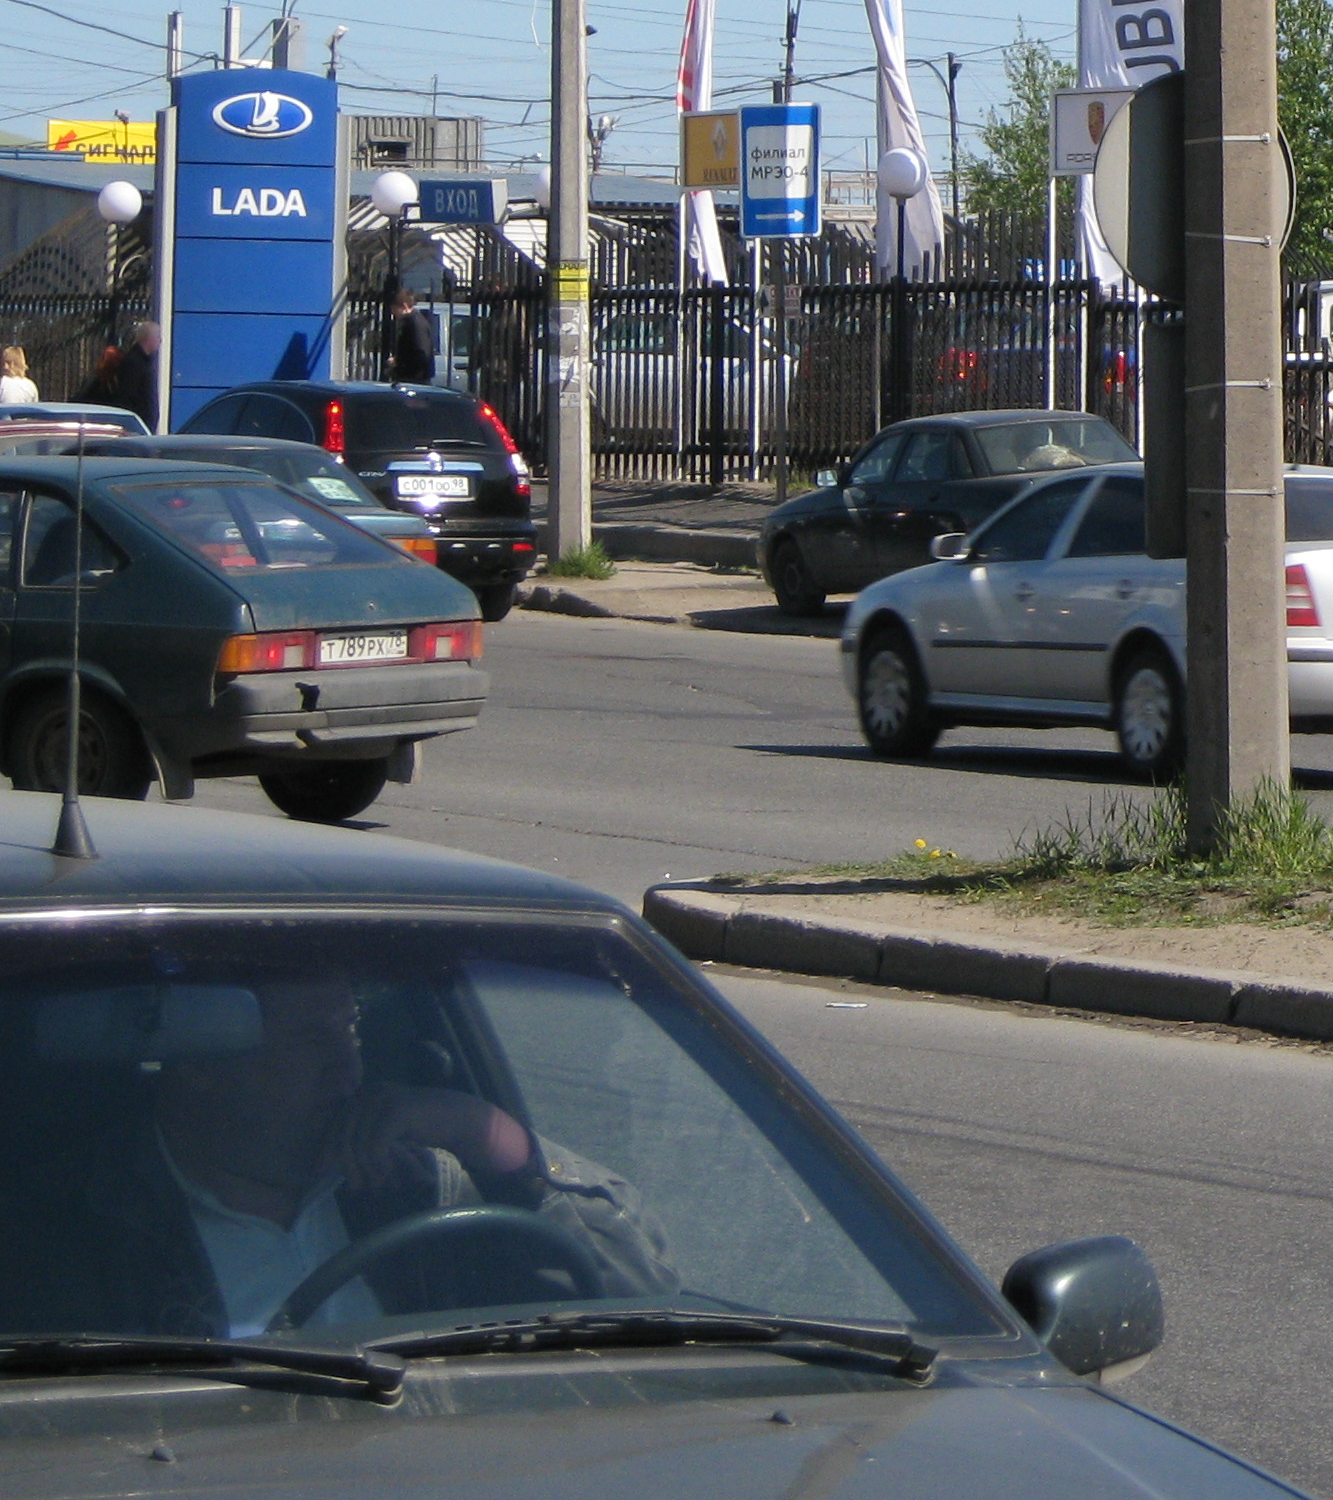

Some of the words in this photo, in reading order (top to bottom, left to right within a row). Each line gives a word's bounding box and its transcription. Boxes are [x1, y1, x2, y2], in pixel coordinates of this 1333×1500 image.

[751, 147, 805, 162] филиал
[751, 166, 809, 179] МРЭО-4
[212, 187, 307, 217] LADA
[434, 189, 479, 218] ВХОД
